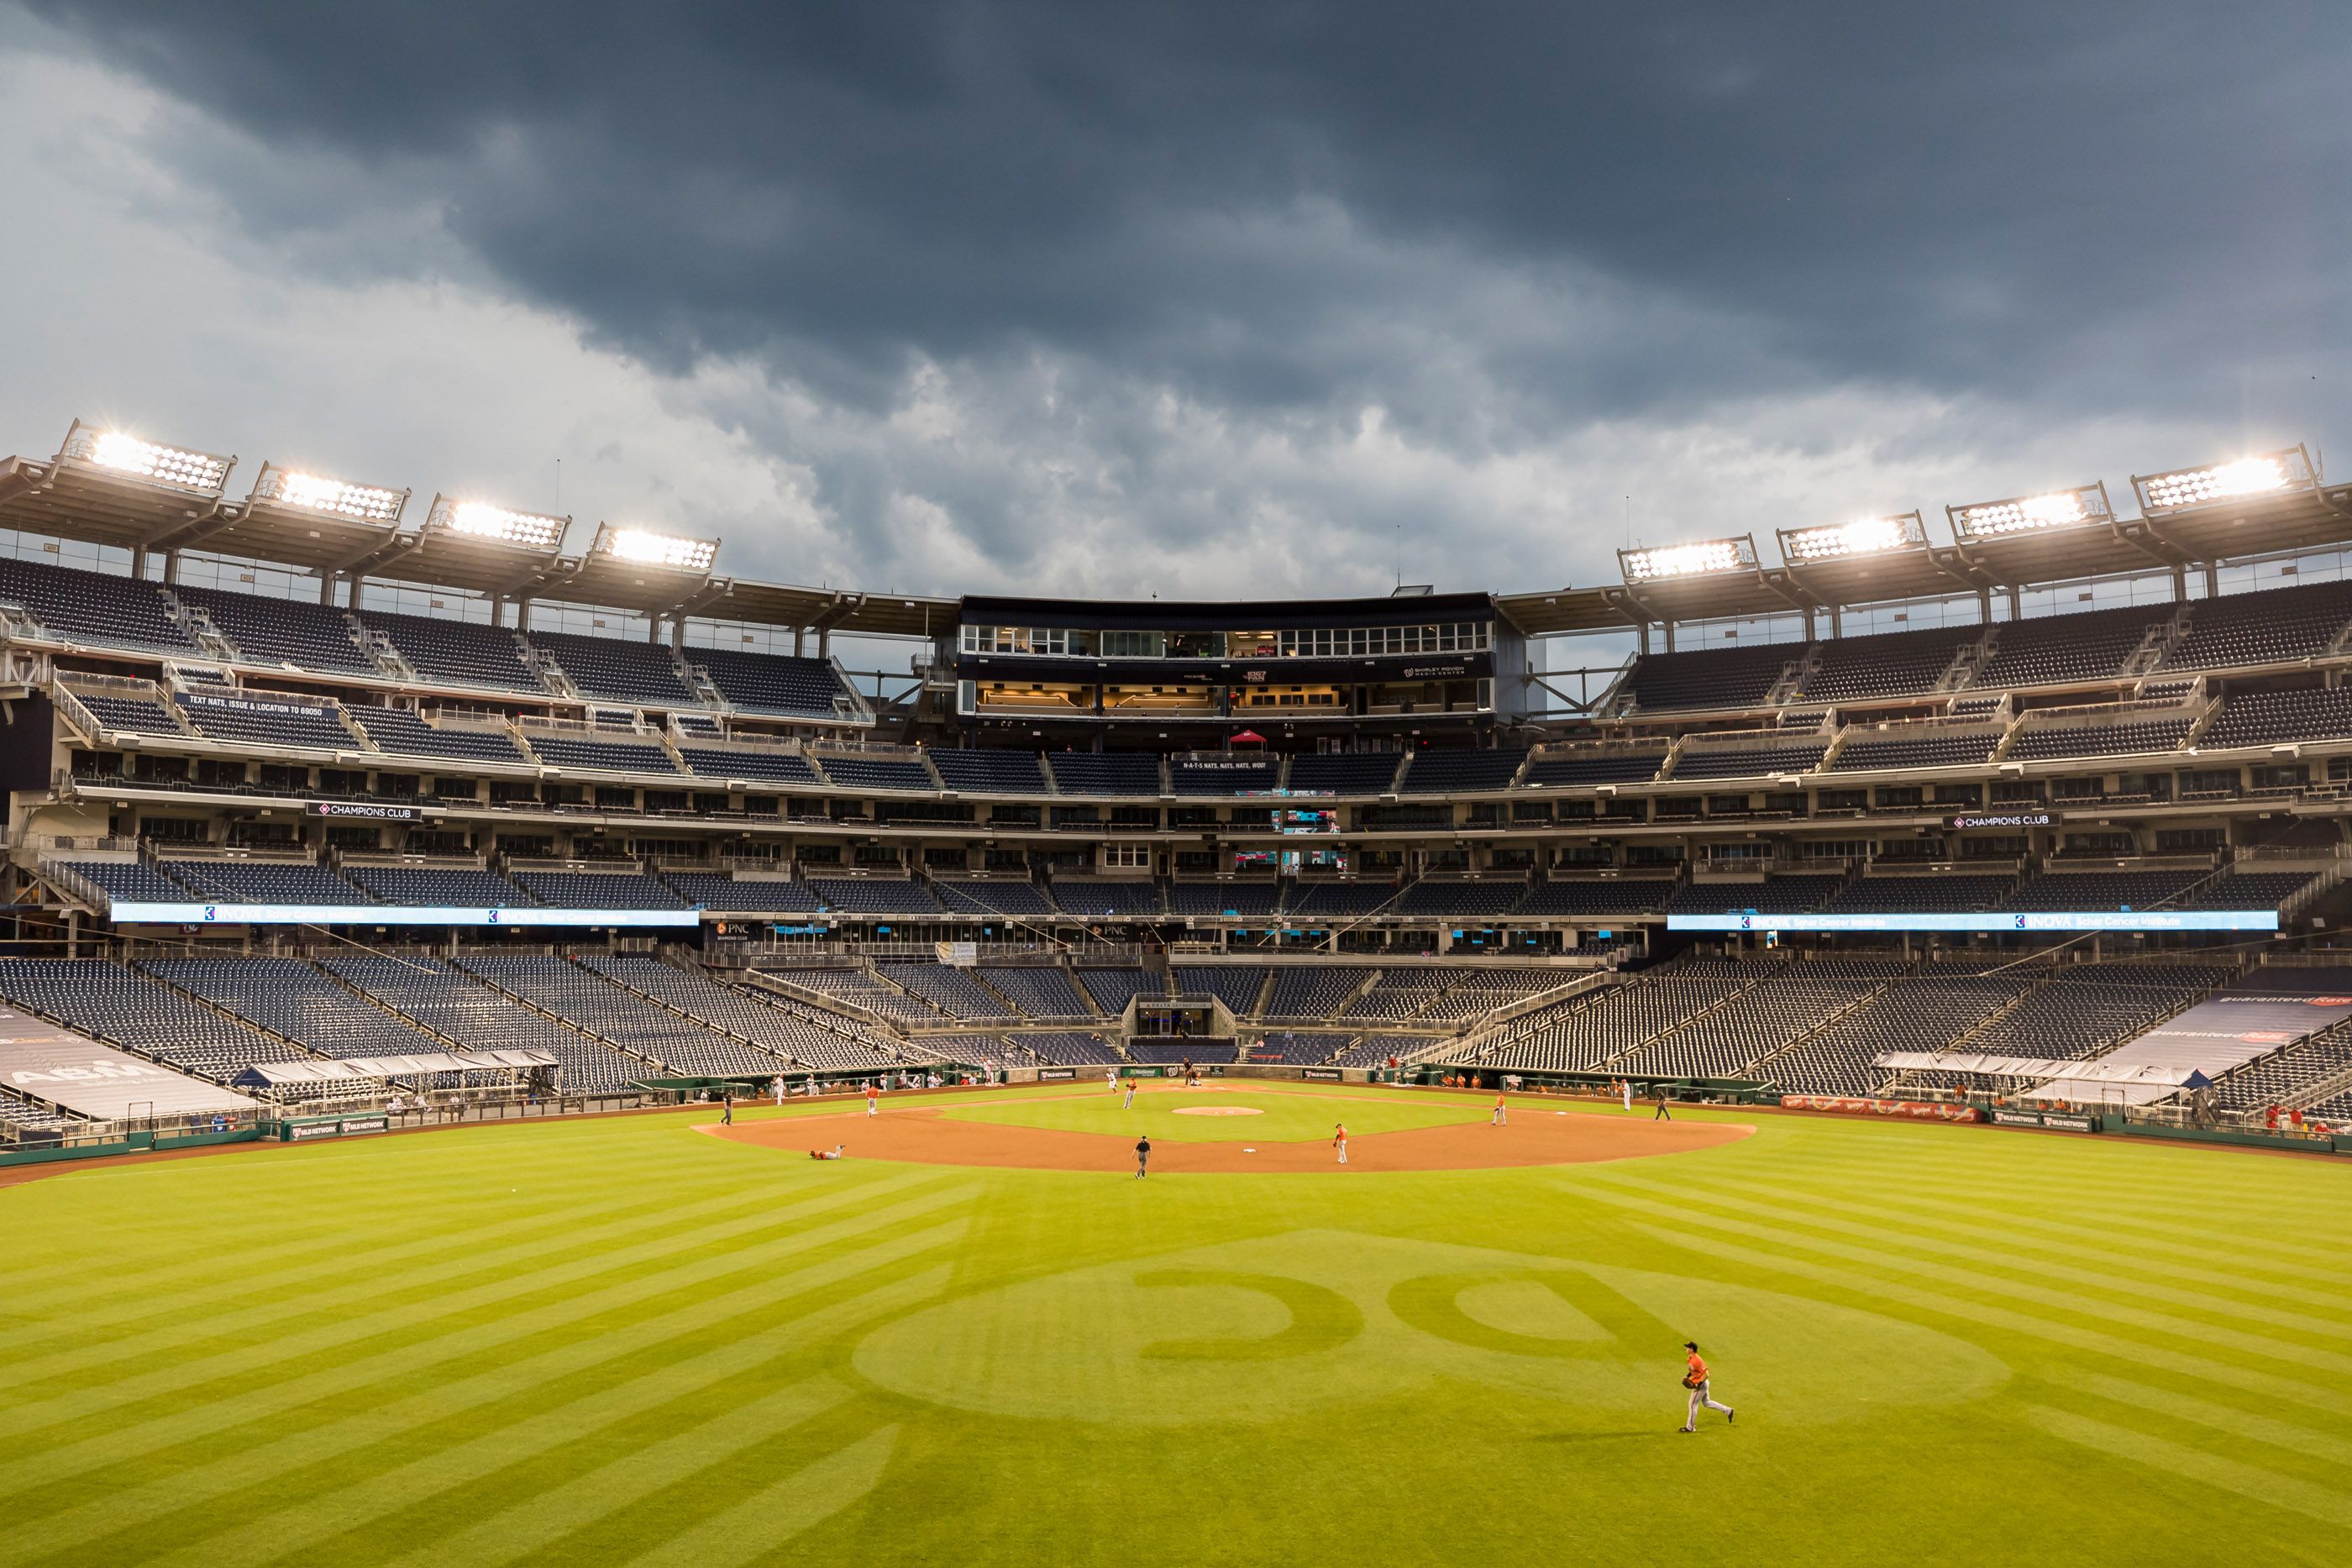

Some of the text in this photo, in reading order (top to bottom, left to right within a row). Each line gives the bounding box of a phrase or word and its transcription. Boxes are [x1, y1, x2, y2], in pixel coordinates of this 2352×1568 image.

[189, 695, 323, 716] TEXT NATS, ISSUE & LOCATION TO 69050
[331, 805, 411, 818] CHAMPIONS CLUB
[1966, 815, 2050, 826] CHAMPIONS CLUB
[218, 906, 260, 920] INOVA
[500, 910, 538, 923] INOVA
[1752, 917, 1790, 928] INOVA
[2029, 915, 2071, 927] INOVA
[2104, 916, 2138, 926] Cancer
[2140, 916, 2181, 926] Institute
[728, 923, 749, 934] PNC
[1104, 926, 1127, 936] PNC
[12, 1062, 160, 1084] ABM
[312, 1126, 336, 1135] NETWORK
